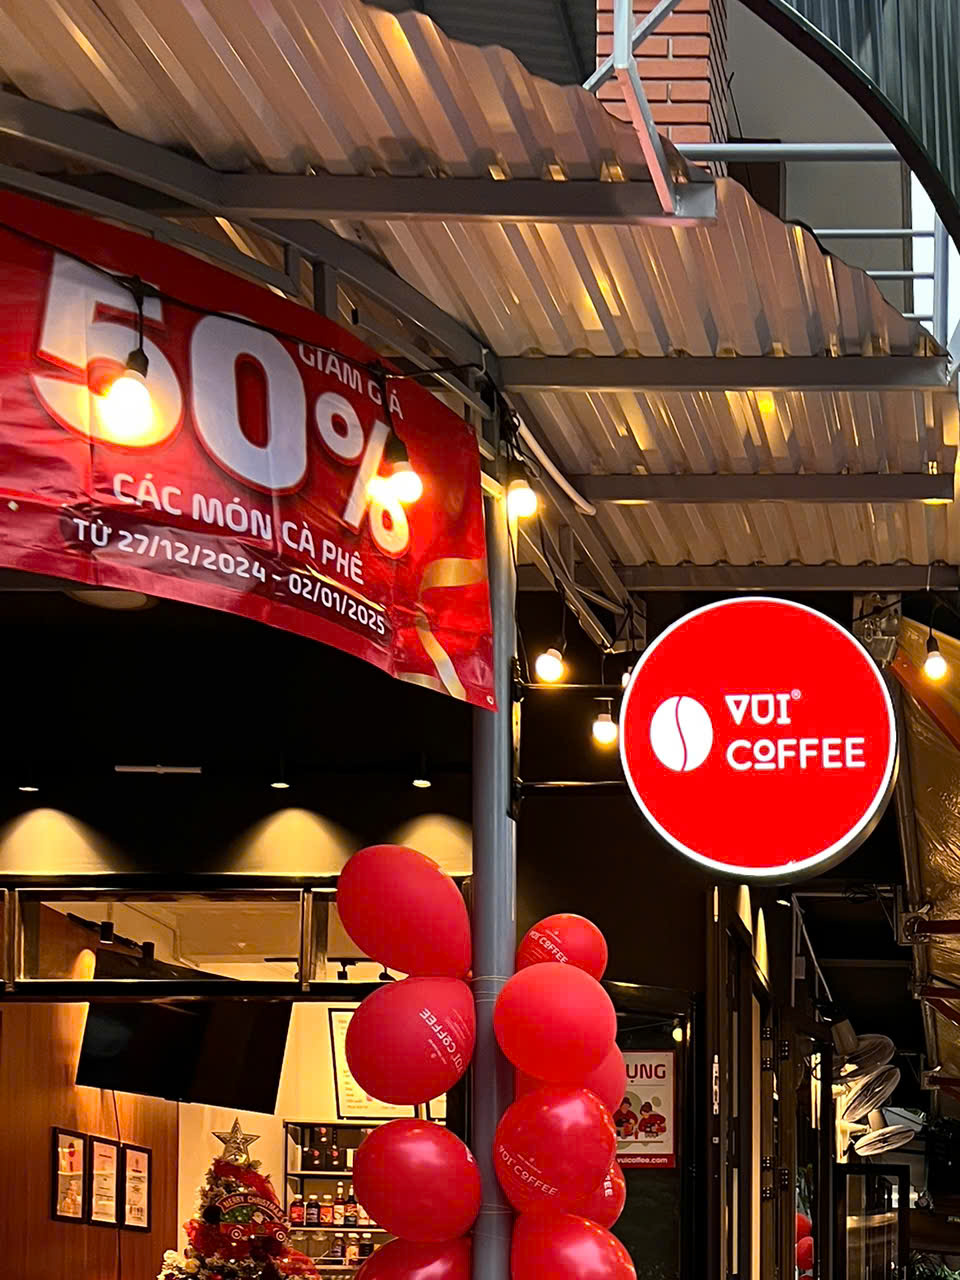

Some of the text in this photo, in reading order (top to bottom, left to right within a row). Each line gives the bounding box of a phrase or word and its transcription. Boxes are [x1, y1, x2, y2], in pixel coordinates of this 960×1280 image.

[31, 252, 410, 556] 50%
[72, 518, 113, 547] TỪ
[117, 529, 267, 584] 27/12/2024
[288, 572, 386, 635] 02/01/2025
[112, 473, 365, 586] CÁC MÓN CÀ PHÊ
[625, 1063, 667, 1084] ỤNG
[513, 1165, 559, 1196] COFFEE
